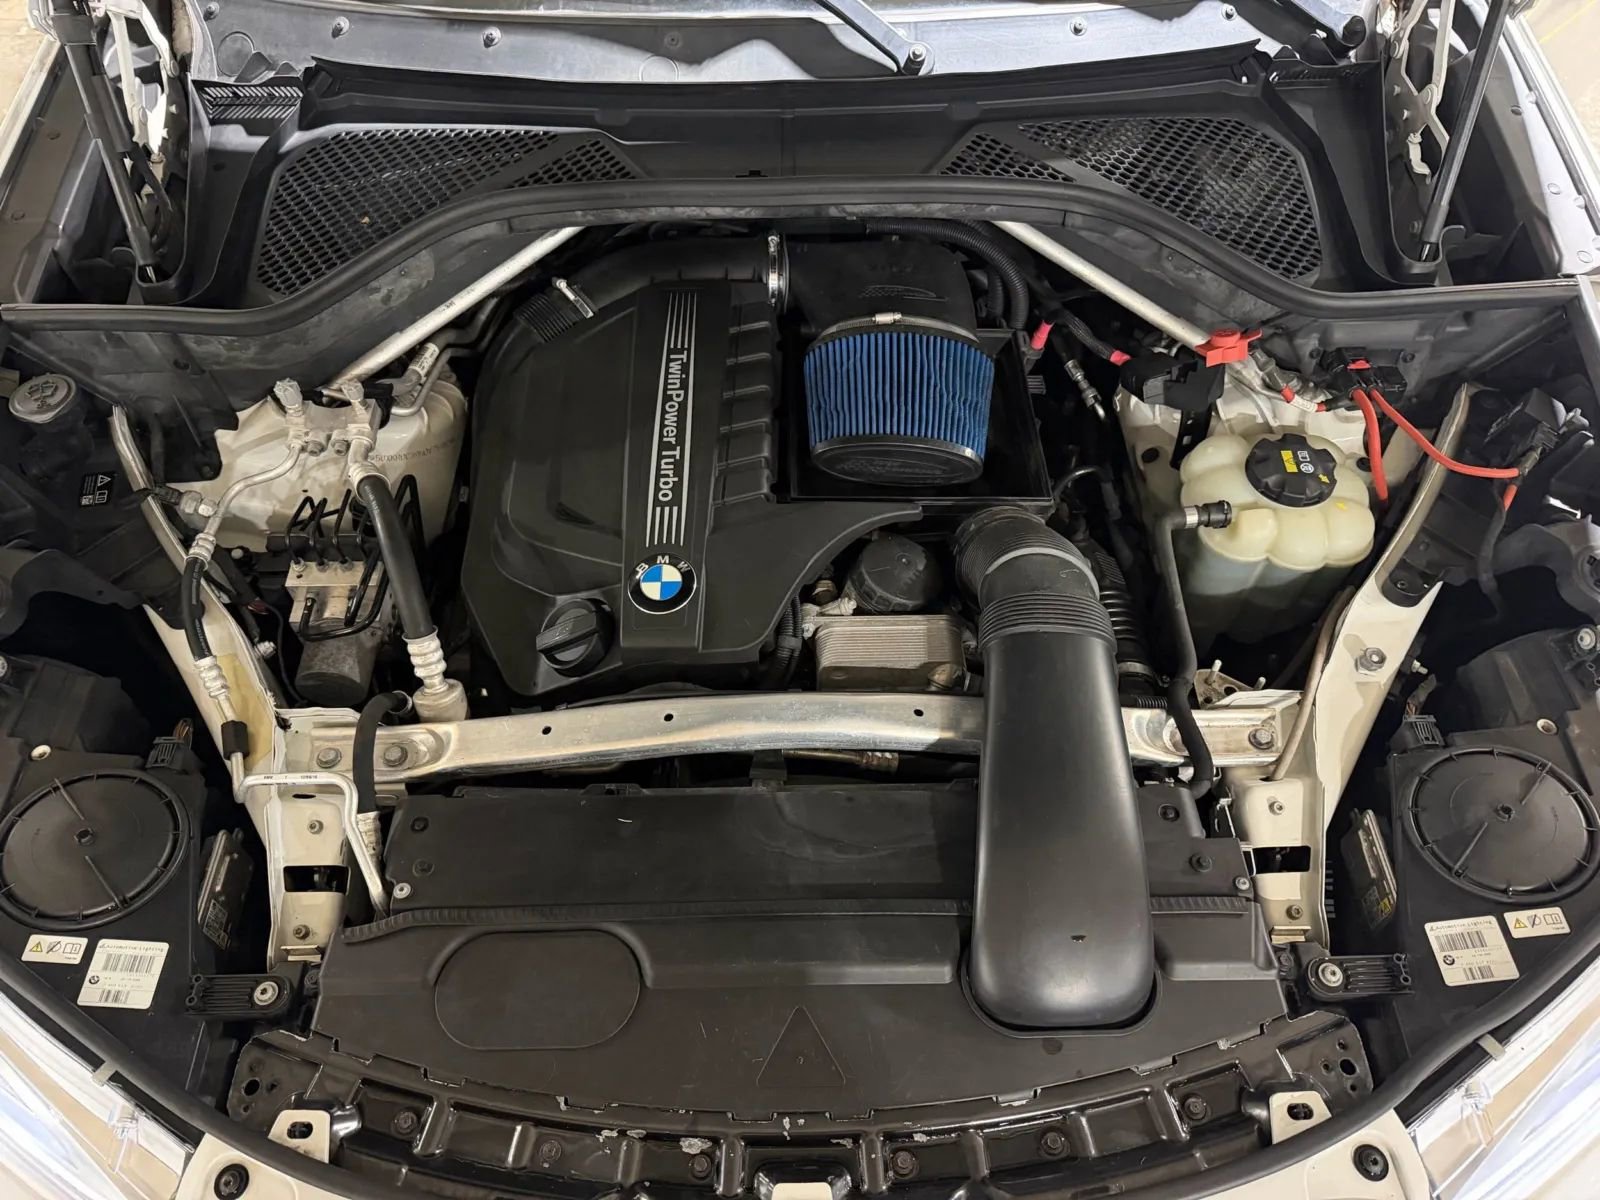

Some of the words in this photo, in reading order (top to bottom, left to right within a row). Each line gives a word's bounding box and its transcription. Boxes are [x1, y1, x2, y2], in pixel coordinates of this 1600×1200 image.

[662, 350, 688, 445] TwinPower
[658, 446, 681, 502] Turbo
[635, 555, 691, 580] BMW
